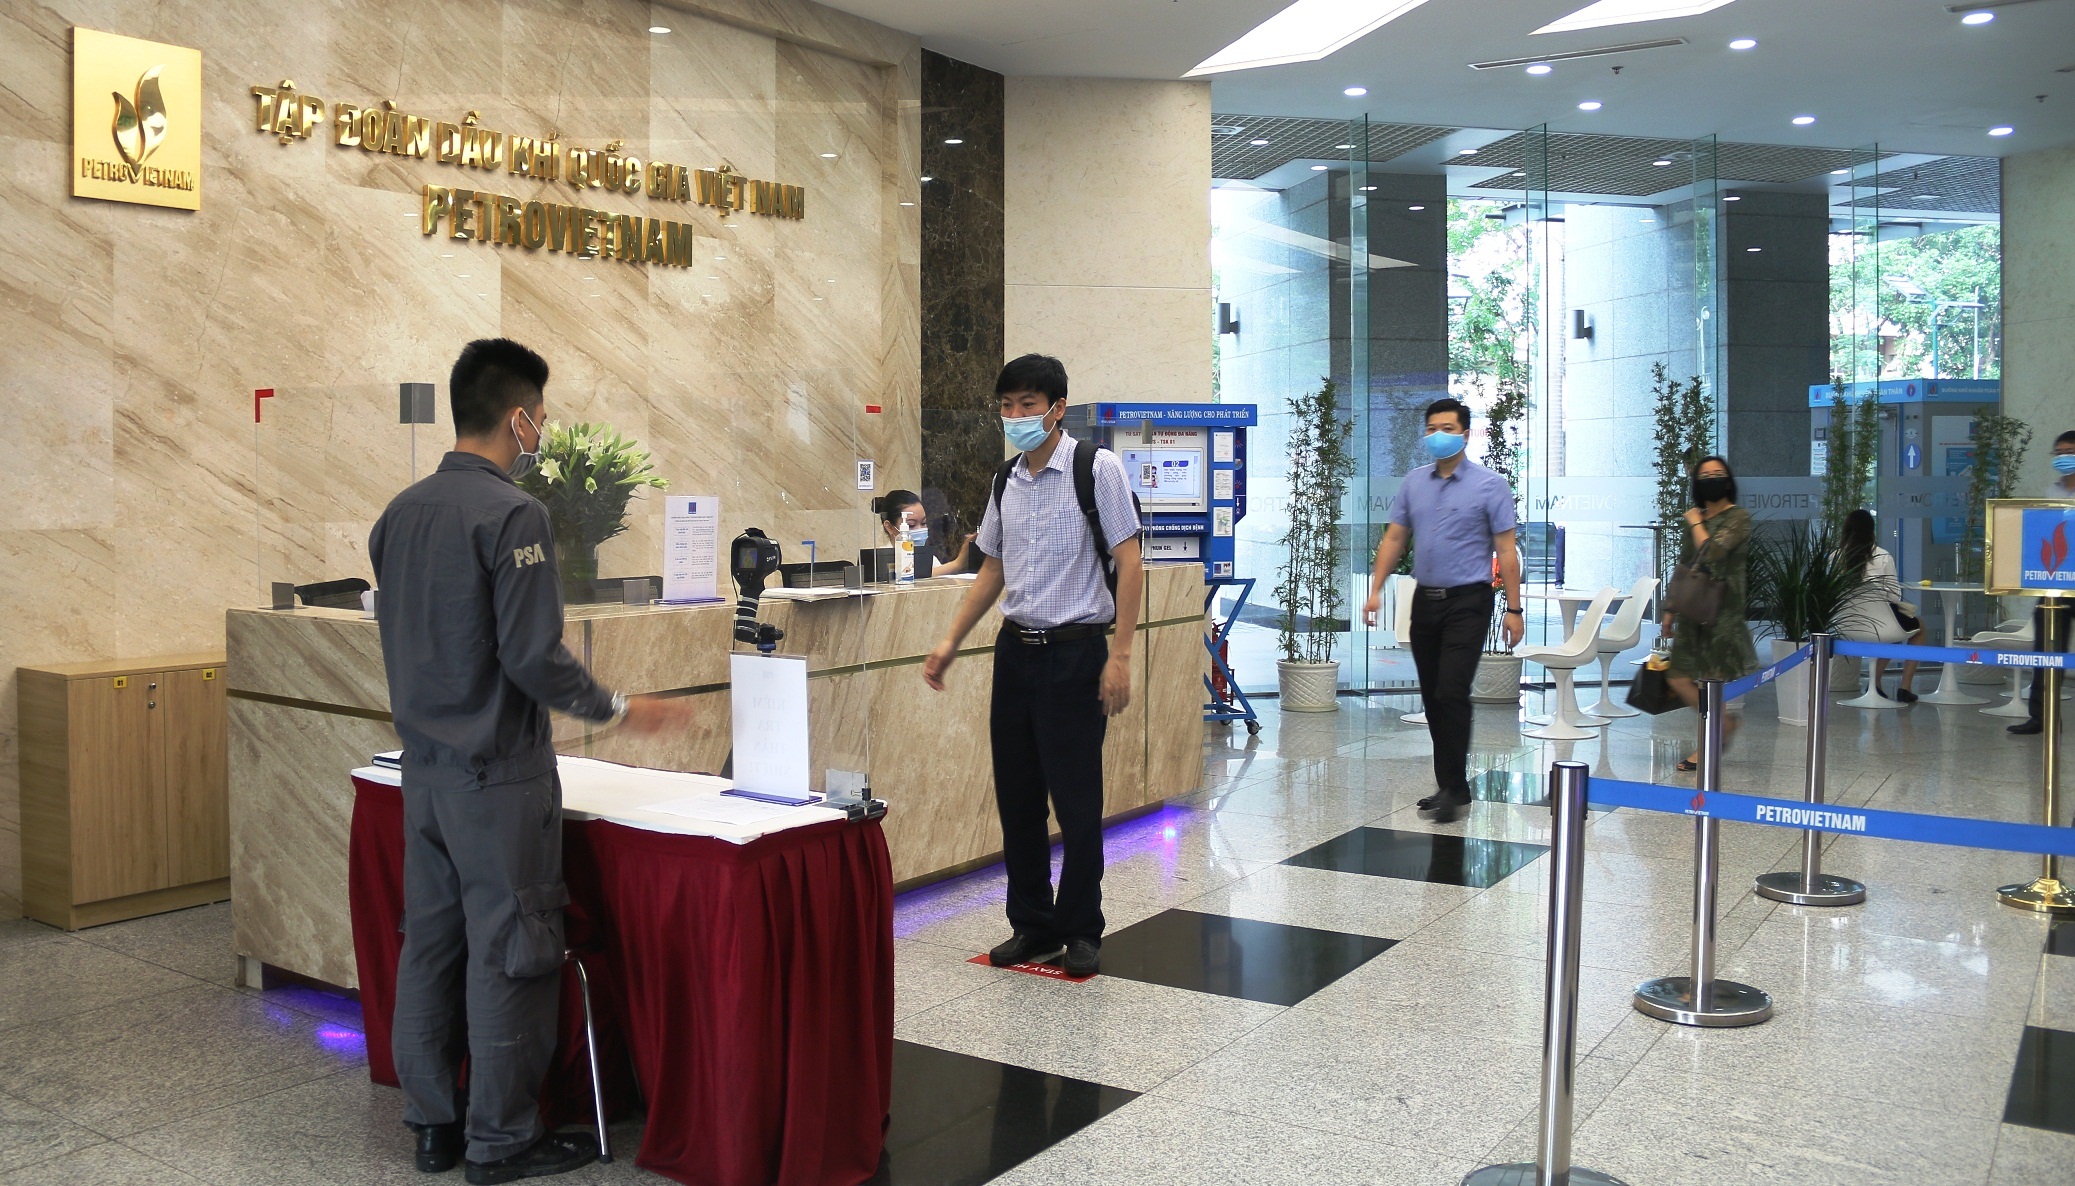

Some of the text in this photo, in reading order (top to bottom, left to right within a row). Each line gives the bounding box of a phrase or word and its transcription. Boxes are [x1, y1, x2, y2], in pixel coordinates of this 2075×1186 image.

[252, 79, 805, 220] TẬP ĐOÀN DẦU KHÍ QUỐC GIA VIỆT NAM
[81, 157, 194, 191] PETROVIETNAM
[422, 183, 693, 268] PETROVIETNAM
[1119, 410, 1163, 419] PETROVIETNAM
[1167, 408, 1183, 419] NĂNG
[1183, 409, 1203, 420] LƯỢNG
[1203, 410, 1216, 419] CHO
[1216, 408, 1231, 419] PHÁT
[1232, 407, 1249, 419] TRIỂN
[513, 543, 546, 569] PSA
[2024, 570, 2075, 581] PETROVIETNA
[1997, 653, 2064, 667] PETROVIETNAM
[1756, 804, 1867, 832] PETROVIETNAM
